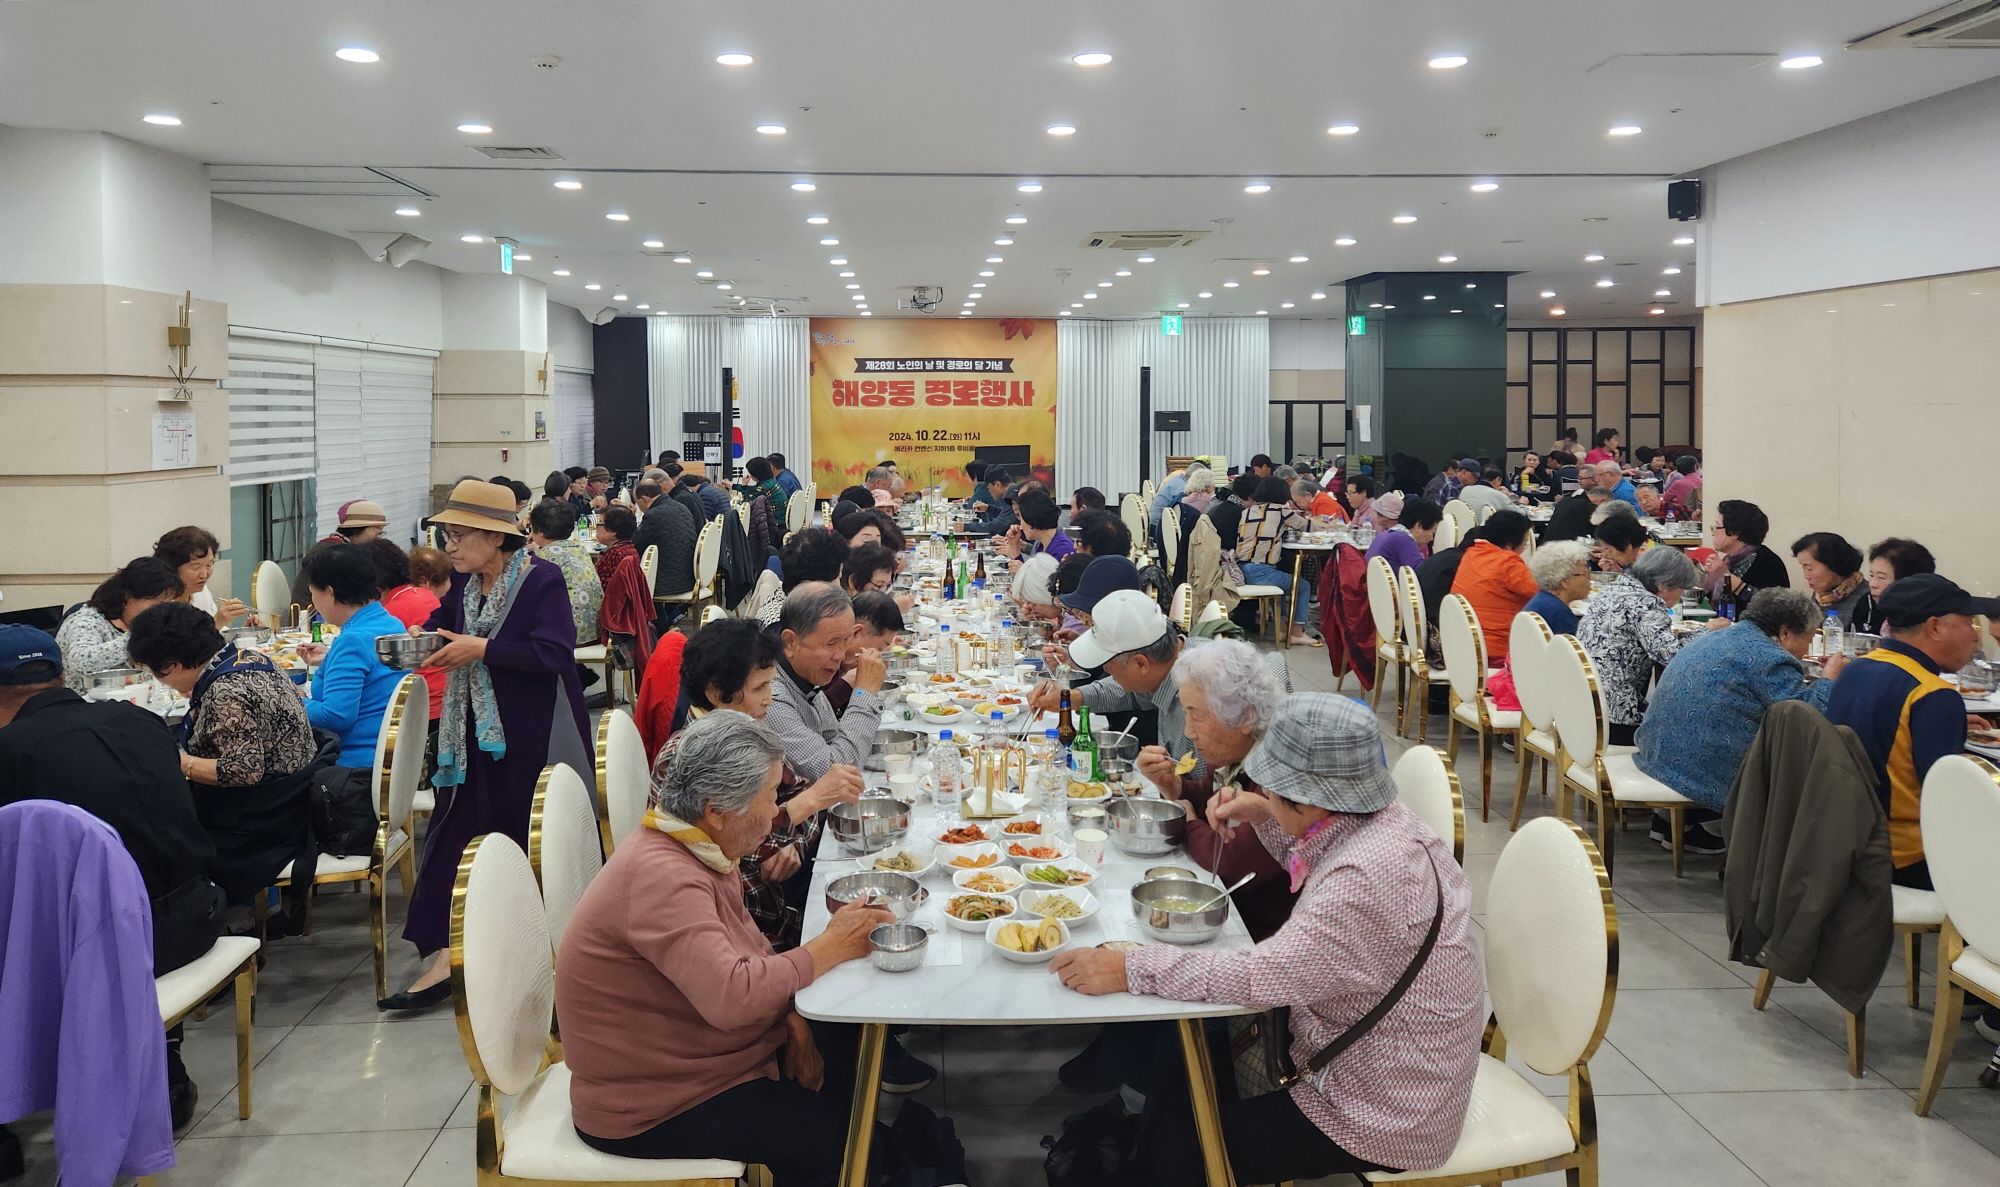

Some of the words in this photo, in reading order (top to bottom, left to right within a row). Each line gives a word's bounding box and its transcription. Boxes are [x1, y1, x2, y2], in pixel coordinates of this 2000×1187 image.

[865, 360, 895, 370] 제28회
[896, 360, 923, 370] 노인의
[925, 360, 934, 370] 날
[936, 360, 945, 370] 및
[946, 360, 973, 371] 경로의
[974, 360, 984, 371] 달
[985, 361, 1003, 371] 기념
[832, 379, 915, 407] 해양동
[925, 379, 1035, 407] 경로행사
[888, 432, 914, 441] 2024.
[915, 430, 931, 441] 10.
[963, 432, 981, 441] 11시
